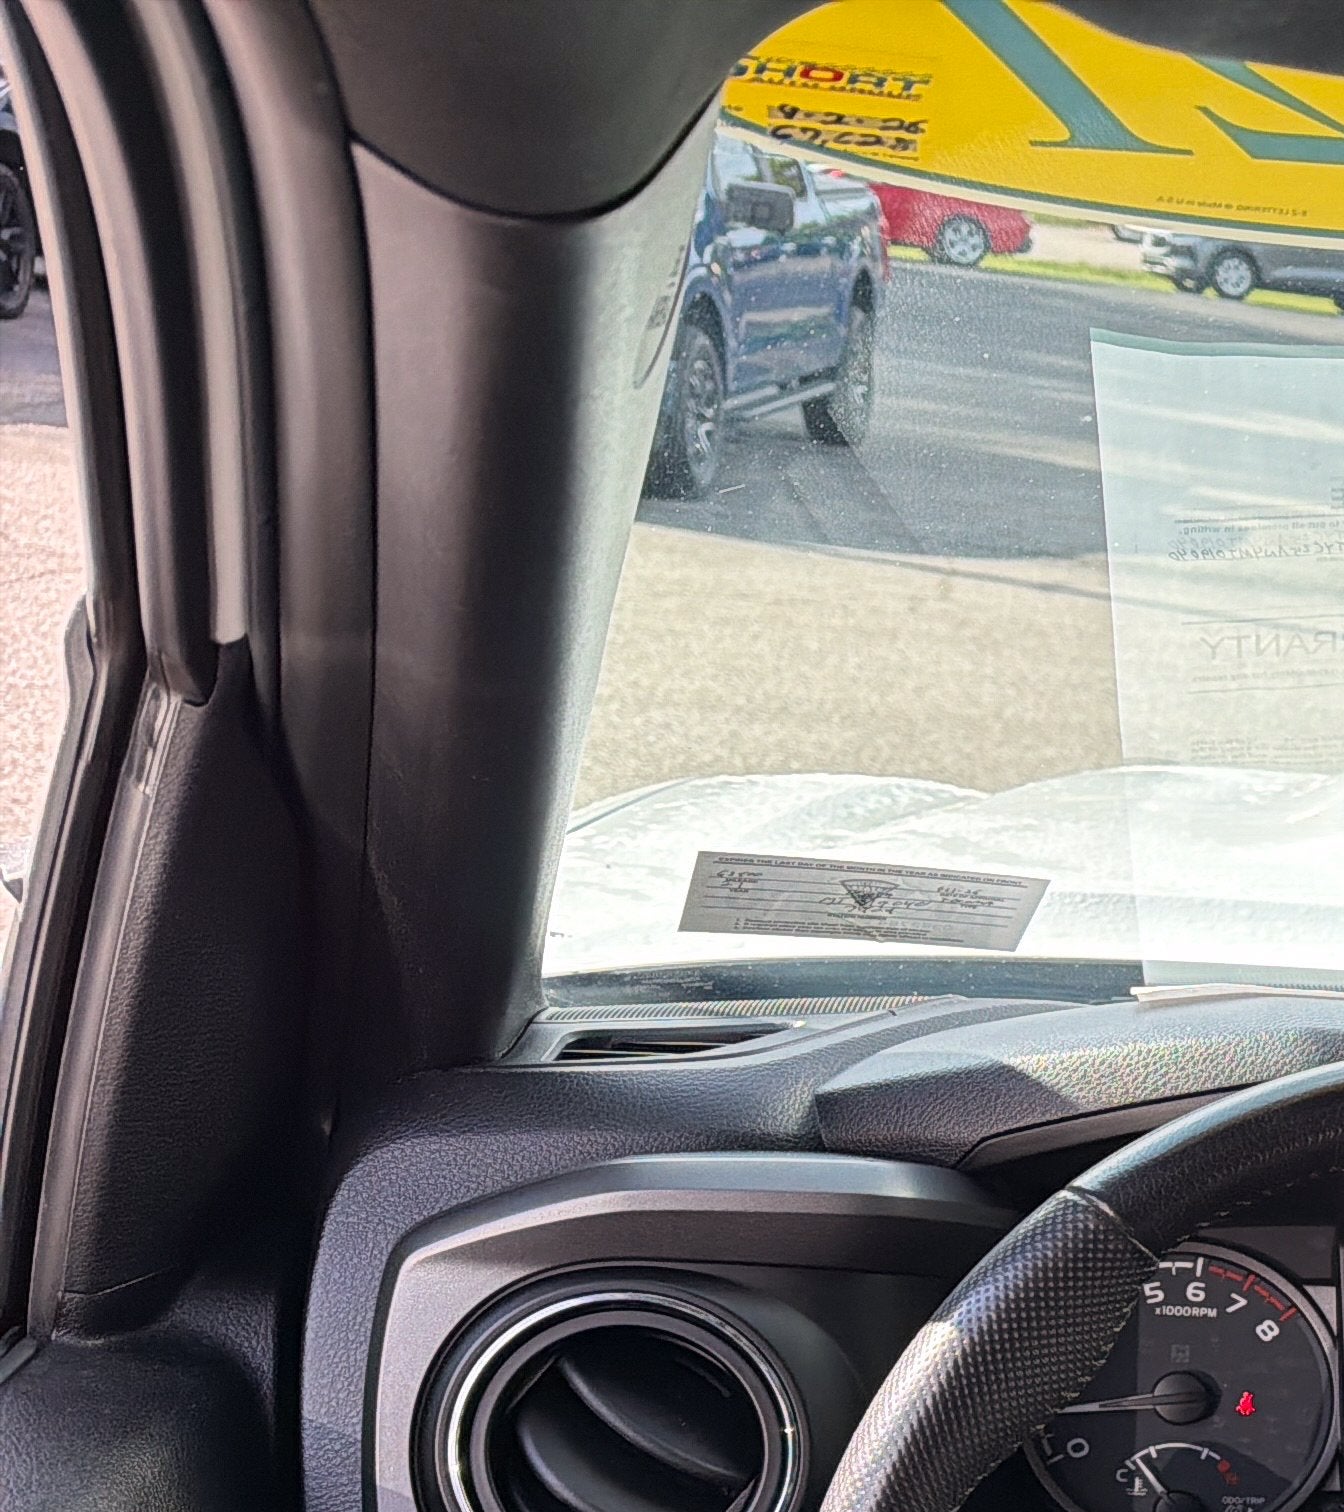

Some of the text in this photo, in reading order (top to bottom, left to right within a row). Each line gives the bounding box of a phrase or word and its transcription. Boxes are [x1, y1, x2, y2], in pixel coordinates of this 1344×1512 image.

[1143, 1282, 1165, 1304] 5
[1186, 1281, 1206, 1302] 6
[1226, 1293, 1248, 1313] 7
[1255, 1319, 1280, 1342] 8
[1066, 1438, 1090, 1459] 0
